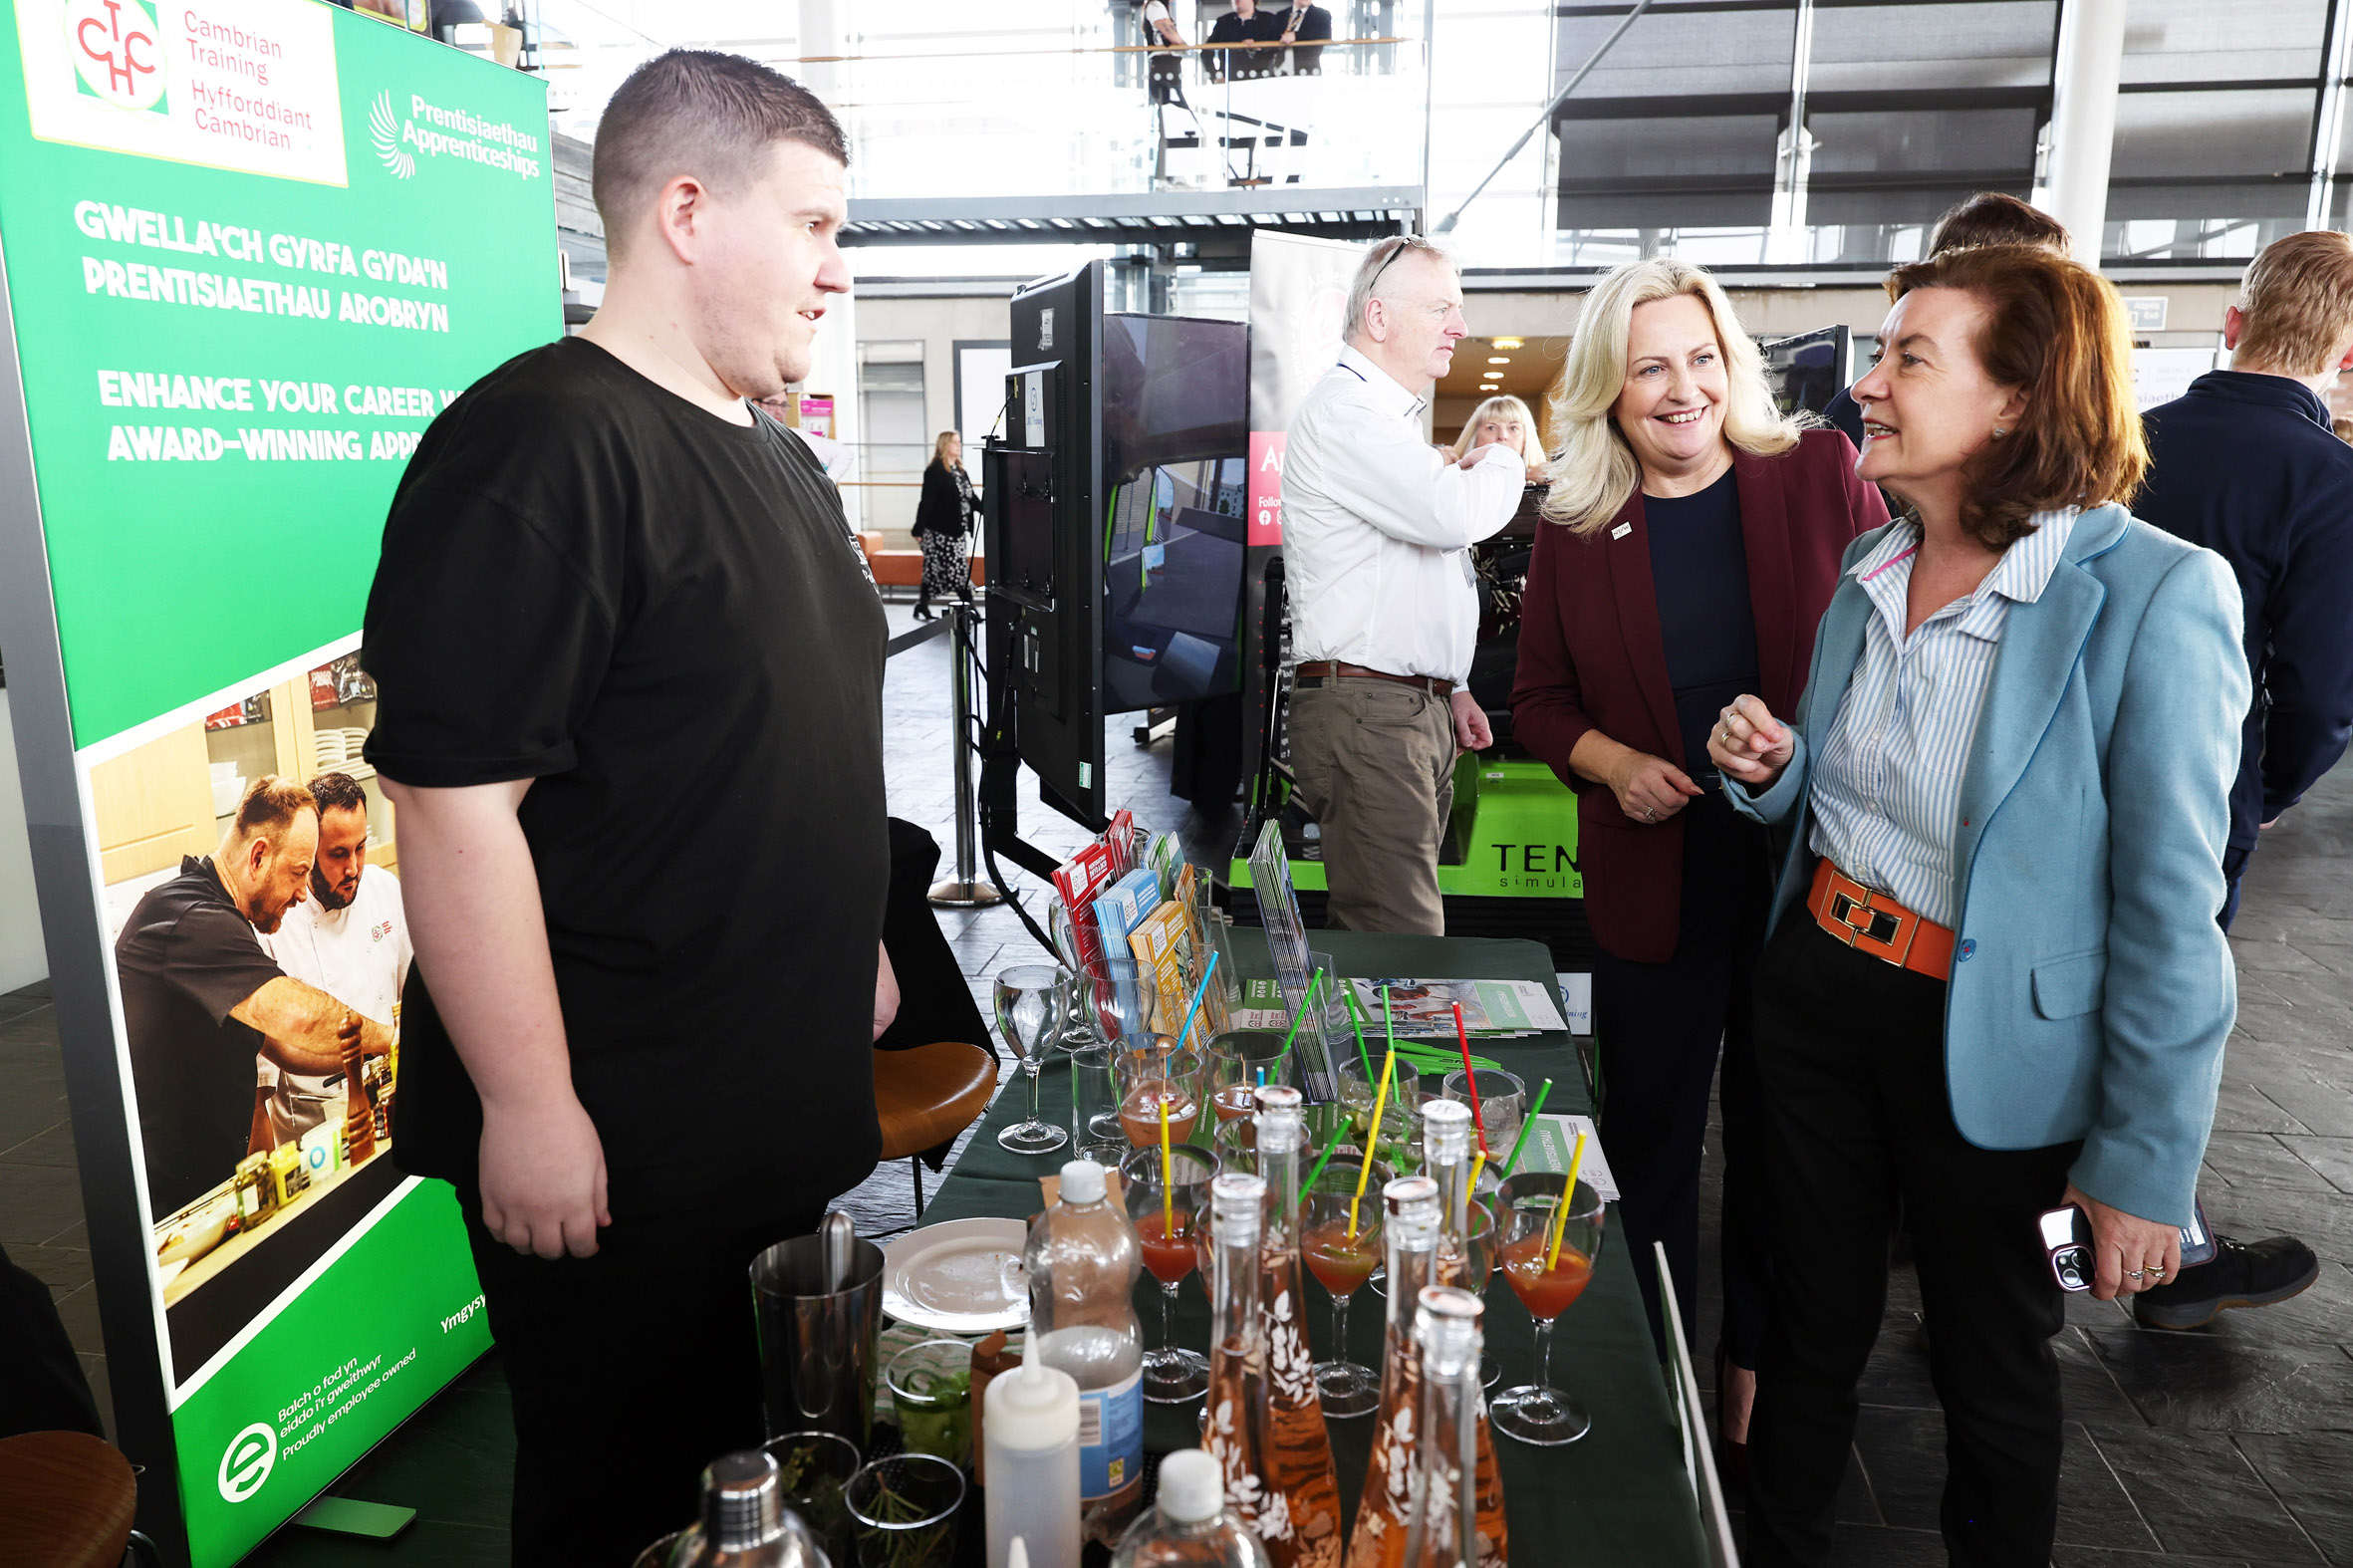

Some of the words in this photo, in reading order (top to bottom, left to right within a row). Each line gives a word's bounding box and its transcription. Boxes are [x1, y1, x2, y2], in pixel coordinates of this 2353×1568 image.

[184, 10, 282, 59] Cambrian
[185, 38, 269, 86] Training
[191, 79, 313, 131] Hyfforddiant
[195, 108, 291, 150] Cambrian
[411, 94, 538, 153] Prentisiaethau
[402, 119, 540, 180] Apprenticeships
[74, 199, 264, 263] GWELLA'CH
[269, 233, 359, 277] GYRFA
[362, 249, 448, 290] GYDA'N
[82, 255, 331, 320] PRENTISIAETHAU
[338, 291, 449, 333] AROBRYN
[98, 369, 254, 411] ENHANCE
[258, 379, 339, 414] YOUR
[344, 385, 436, 417] CAREER
[108, 424, 363, 461] AWARD-WINNING
[1491, 844, 1581, 874] TEN
[1499, 875, 1581, 889] simula
[278, 1392, 312, 1423] Balch
[313, 1385, 322, 1396] o
[323, 1368, 343, 1390] fod
[343, 1358, 358, 1378] yn
[280, 1406, 314, 1438] eiddo
[315, 1397, 327, 1412] i'r
[327, 1354, 383, 1405] gweithwyr
[282, 1420, 326, 1461] Proudly
[327, 1378, 381, 1426] employee
[382, 1347, 416, 1383] owned
